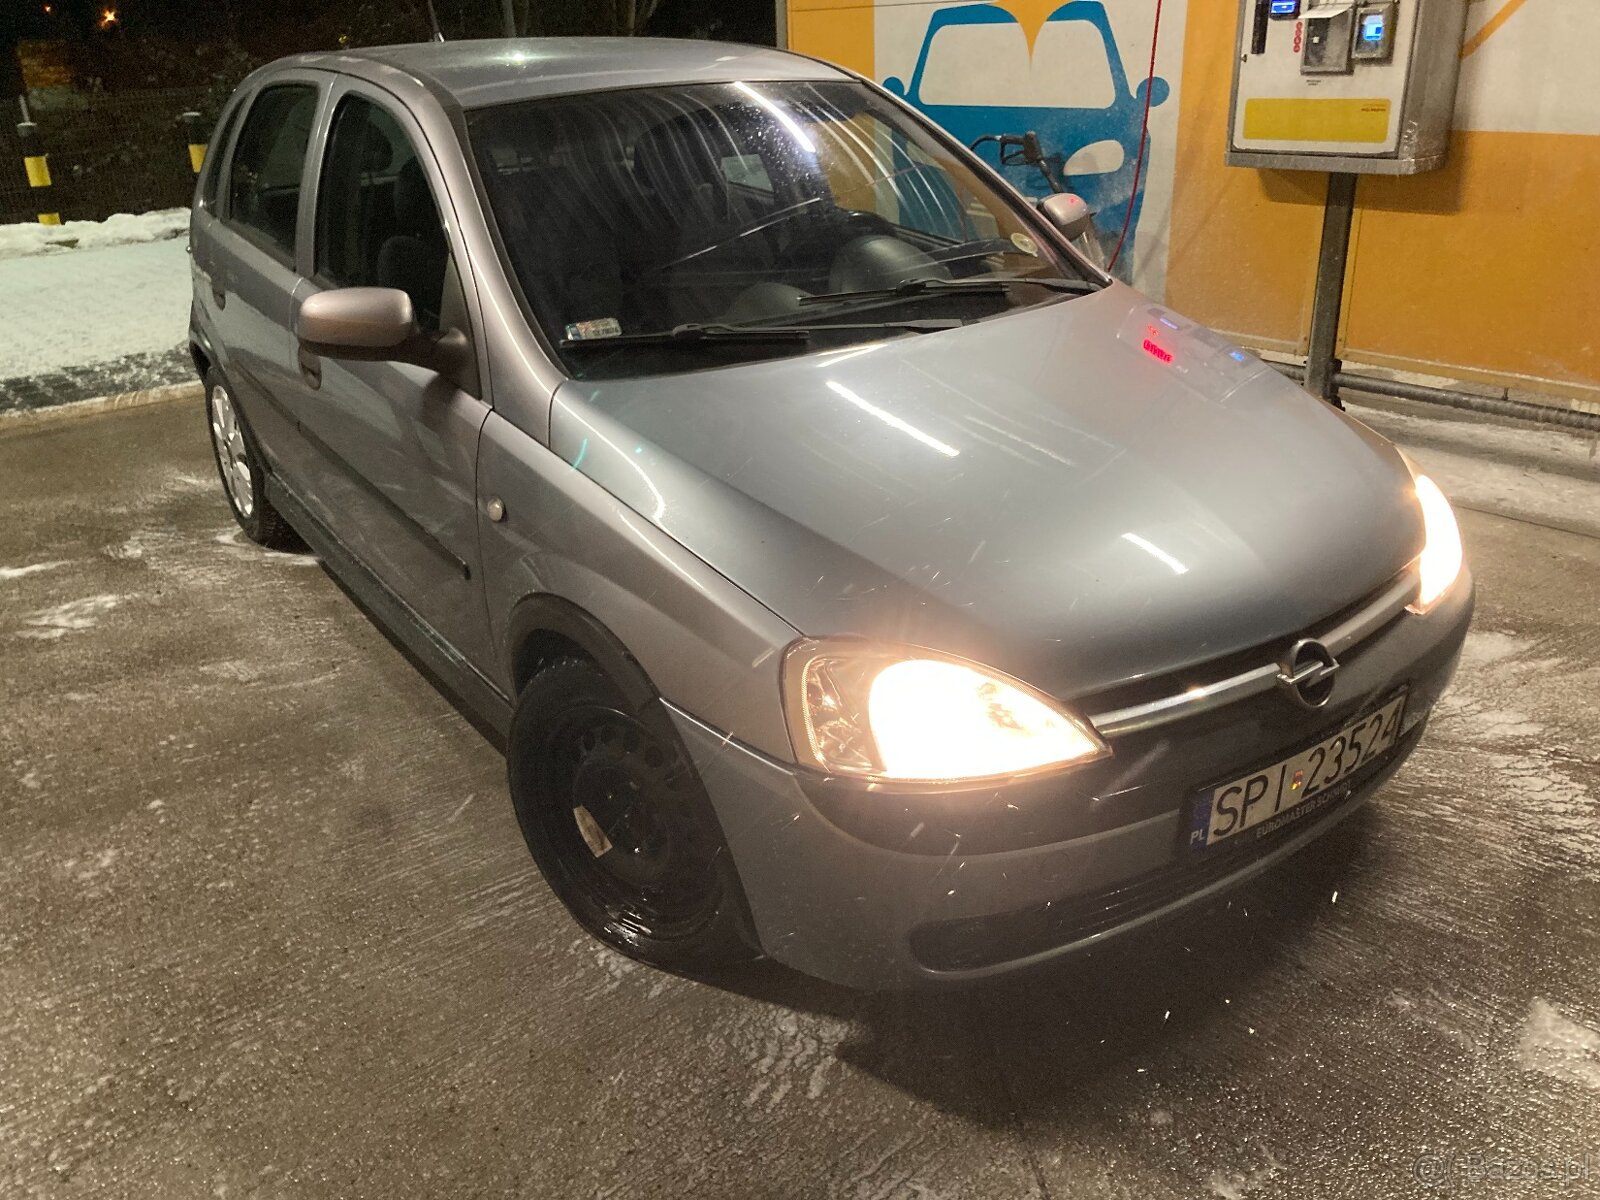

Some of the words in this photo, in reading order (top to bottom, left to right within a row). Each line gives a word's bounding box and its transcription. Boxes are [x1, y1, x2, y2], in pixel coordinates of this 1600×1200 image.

[1213, 764, 1288, 836] SPI
[1301, 697, 1405, 798] 23524
[1190, 829, 1206, 845] PL
